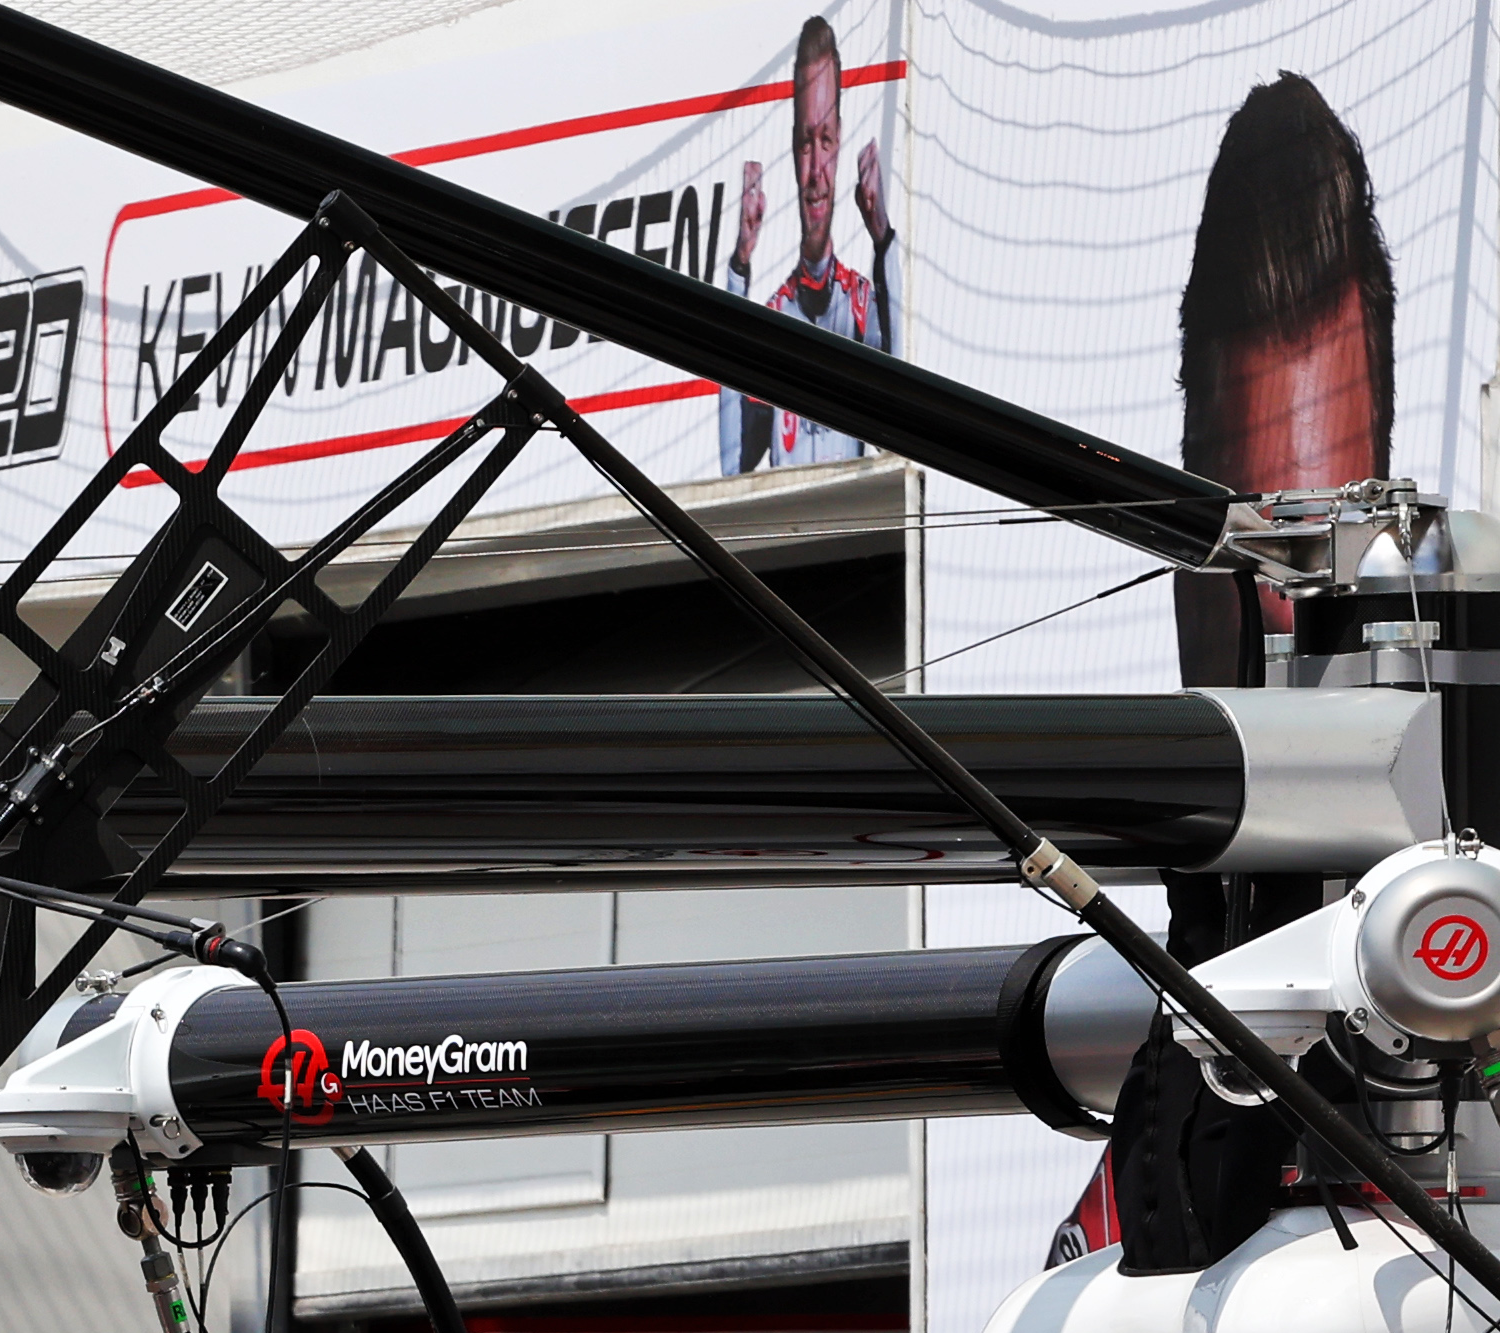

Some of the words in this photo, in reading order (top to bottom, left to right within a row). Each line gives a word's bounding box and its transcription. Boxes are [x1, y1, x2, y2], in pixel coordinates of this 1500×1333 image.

[341, 1034, 528, 1083] MoneyGram
[348, 1092, 425, 1115] HAAS
[430, 1090, 457, 1111] F1
[461, 1087, 543, 1107] TEAM
